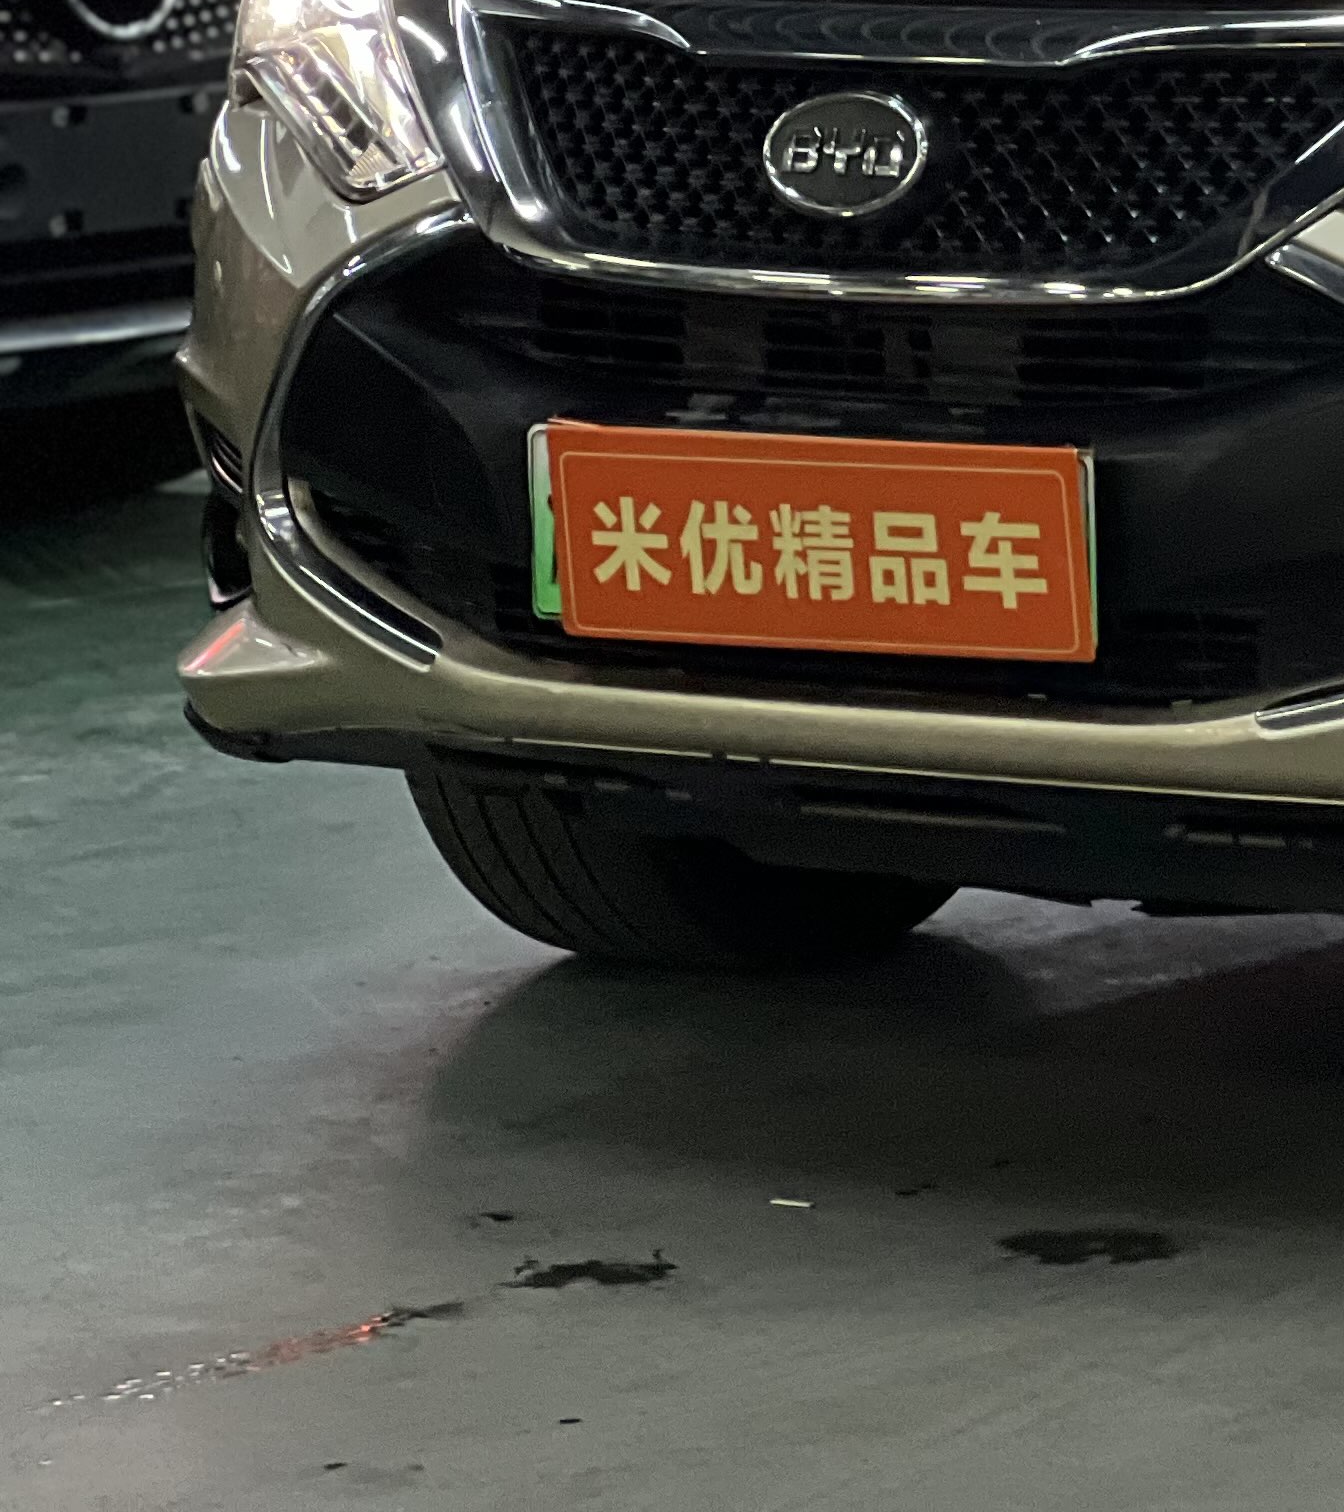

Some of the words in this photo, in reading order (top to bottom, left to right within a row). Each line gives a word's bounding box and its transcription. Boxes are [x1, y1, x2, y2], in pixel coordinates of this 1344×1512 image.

[783, 126, 904, 178] BYD
[590, 496, 1048, 610] 米优精品车
